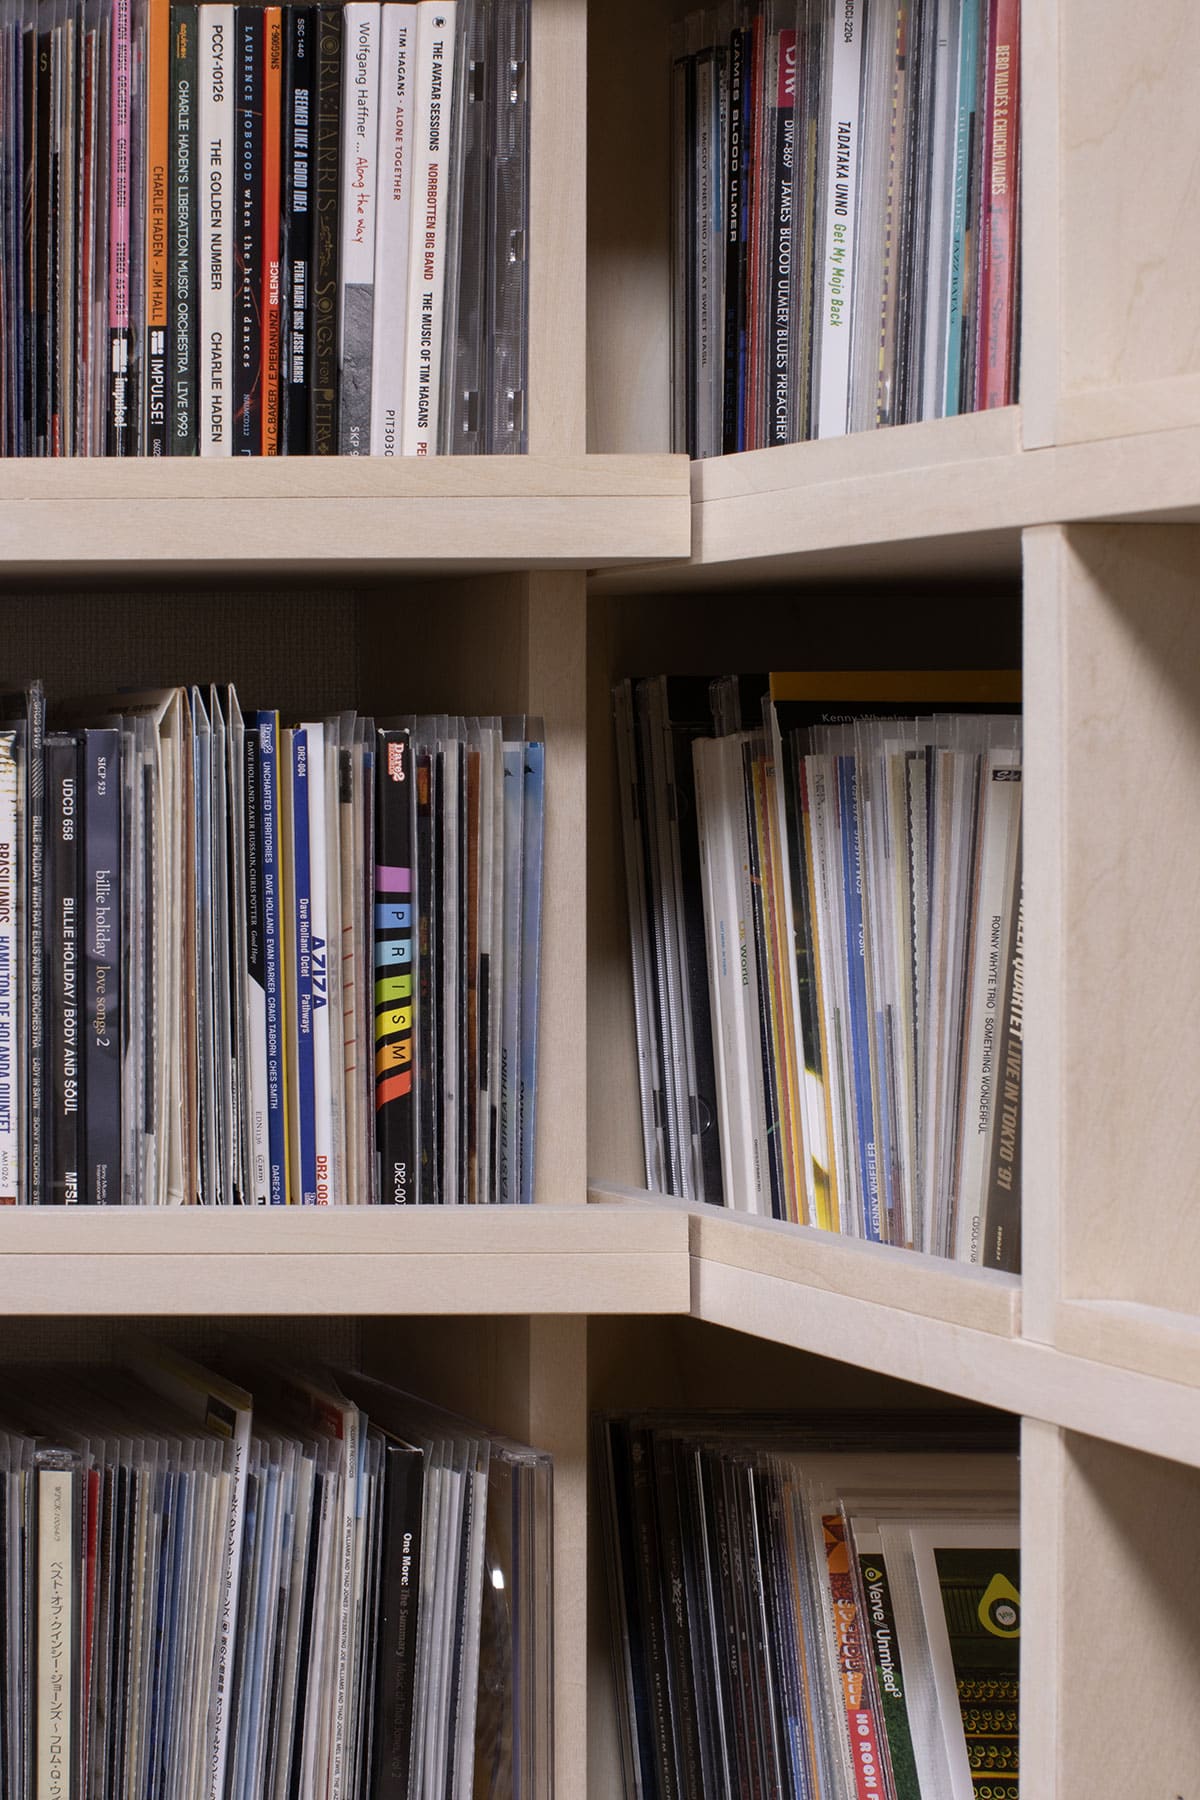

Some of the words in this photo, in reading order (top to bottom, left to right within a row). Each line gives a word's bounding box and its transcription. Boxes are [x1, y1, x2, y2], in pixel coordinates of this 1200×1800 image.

[296, 18, 306, 36] SSC
[396, 28, 407, 48] TIM
[118, 44, 126, 70] MUSIC
[212, 25, 224, 102] PCCY-10126
[244, 26, 253, 102] LAURENCE
[355, 22, 370, 84] Wolfgang
[432, 41, 444, 60] THE
[996, 45, 1010, 70] BEBO
[397, 52, 406, 97] HAGANS
[431, 62, 443, 100] AVATAR
[117, 76, 126, 126] ORCHESTRA
[178, 80, 188, 130] CHARLIE
[292, 89, 309, 126] SEEMED
[356, 90, 369, 138] Haffner
[292, 128, 308, 149] LIKE
[395, 107, 404, 142] ALONE
[429, 102, 442, 152] SESSIONS
[732, 109, 740, 172] BLOOD
[993, 120, 1007, 157] CHUCHO
[178, 134, 188, 182] HADEN'S
[211, 139, 222, 165] THE
[244, 110, 252, 182] HOBGOOD
[836, 122, 851, 178] TADATAKA
[292, 161, 308, 188] GOOD
[352, 157, 368, 188] Along
[393, 146, 402, 200] TOGETHER
[153, 166, 164, 214] CHARLIE
[210, 172, 222, 228] GOLDEN
[292, 190, 308, 213] IDEA
[357, 193, 370, 214] the
[426, 164, 439, 229] NORRBOTTEN
[780, 180, 793, 222] JAMES
[834, 184, 850, 216] UNNO
[178, 186, 188, 256] LIBERATION
[244, 190, 252, 228] when
[730, 180, 738, 242] ULMER
[152, 218, 164, 262] HADEN
[352, 219, 366, 243] way
[425, 232, 436, 248] BIG
[834, 224, 847, 244] Get
[211, 234, 222, 290] NUMBER
[244, 236, 252, 260] the
[778, 228, 791, 274] BLOOD
[830, 248, 845, 262] My
[152, 269, 164, 288] JIM
[178, 260, 188, 298] MUSIC
[292, 260, 305, 283] PETRA
[424, 252, 436, 280] BAND
[828, 267, 845, 294] Mojo
[244, 268, 252, 308] heart
[270, 262, 279, 304] SILENCE
[292, 285, 305, 308] HADEN
[152, 292, 164, 320] HALL
[422, 292, 433, 311] THE
[830, 298, 844, 327] Back
[292, 310, 305, 330] SINGS
[314, 280, 336, 357] SONGS
[420, 314, 432, 346] MUSIC
[178, 304, 188, 373] ORCHESTRA
[244, 316, 252, 368] dances
[292, 332, 305, 354] JESSE
[211, 332, 222, 389] CHARLIE
[292, 356, 305, 384] HARRIS
[420, 349, 431, 362] OF
[418, 364, 430, 384] TIM
[151, 359, 164, 425] IMPULSE!
[178, 381, 188, 408] LIVE
[418, 386, 430, 428] HAGANS
[776, 374, 788, 440] PREACHER
[178, 411, 188, 437] 1993
[211, 395, 222, 442] HADEN
[97, 756, 106, 779] SICP
[248, 741, 256, 762] DAVE
[393, 743, 405, 782] Dare2
[62, 778, 73, 815] UDCD
[97, 780, 106, 796] 523
[264, 761, 273, 811] UNCHARTED
[32, 815, 42, 842] BILLIE
[62, 819, 73, 840] 658
[264, 812, 273, 863] TERRITORIES
[32, 845, 42, 884] HOLIDAY
[32, 886, 42, 908] WITH
[96, 870, 110, 904] billie
[266, 874, 274, 894] DAVE
[32, 910, 42, 928] RAY
[63, 897, 74, 938] BILLIE
[250, 890, 258, 925] POTTER
[266, 896, 275, 934] HOLLAND
[300, 898, 309, 919] Dave
[93, 906, 110, 956] holiday
[300, 921, 310, 953] Holland
[990, 916, 1000, 949] RONNY
[267, 938, 276, 960] EVAN
[64, 942, 75, 998] HOLIDAY
[96, 965, 110, 994] love
[267, 962, 276, 992] PARKER
[301, 955, 310, 976] Octet
[312, 936, 326, 1010] AZIZA
[988, 952, 999, 984] WHYTE
[392, 910, 405, 1060] PRISM
[986, 986, 997, 1008] TRIO
[93, 996, 110, 1034] songs
[268, 996, 276, 1022] CRAIG
[301, 994, 312, 1033] Pathways
[64, 1008, 76, 1045] BODY
[96, 1038, 110, 1046] 2
[268, 1024, 278, 1056] TABORN
[982, 1018, 994, 1073] SOMETHING
[1007, 1040, 1020, 1078] LIVE
[64, 1048, 76, 1076] AND
[270, 1060, 278, 1082] CHES
[64, 1080, 76, 1116] SOUL
[270, 1083, 278, 1109] SMITH
[1004, 1080, 1019, 1098] IN
[978, 1076, 990, 1135] WONDERFUL
[1000, 1104, 1018, 1162] TOKYO
[317, 1155, 328, 1180] DR2
[997, 1166, 1012, 1190] '91
[402, 1532, 412, 1554] One
[400, 1556, 412, 1586] More:
[400, 1588, 410, 1608] The
[396, 1608, 408, 1657] Summary
[856, 1713, 870, 1736] NO
[859, 1742, 878, 1788] ROOM
